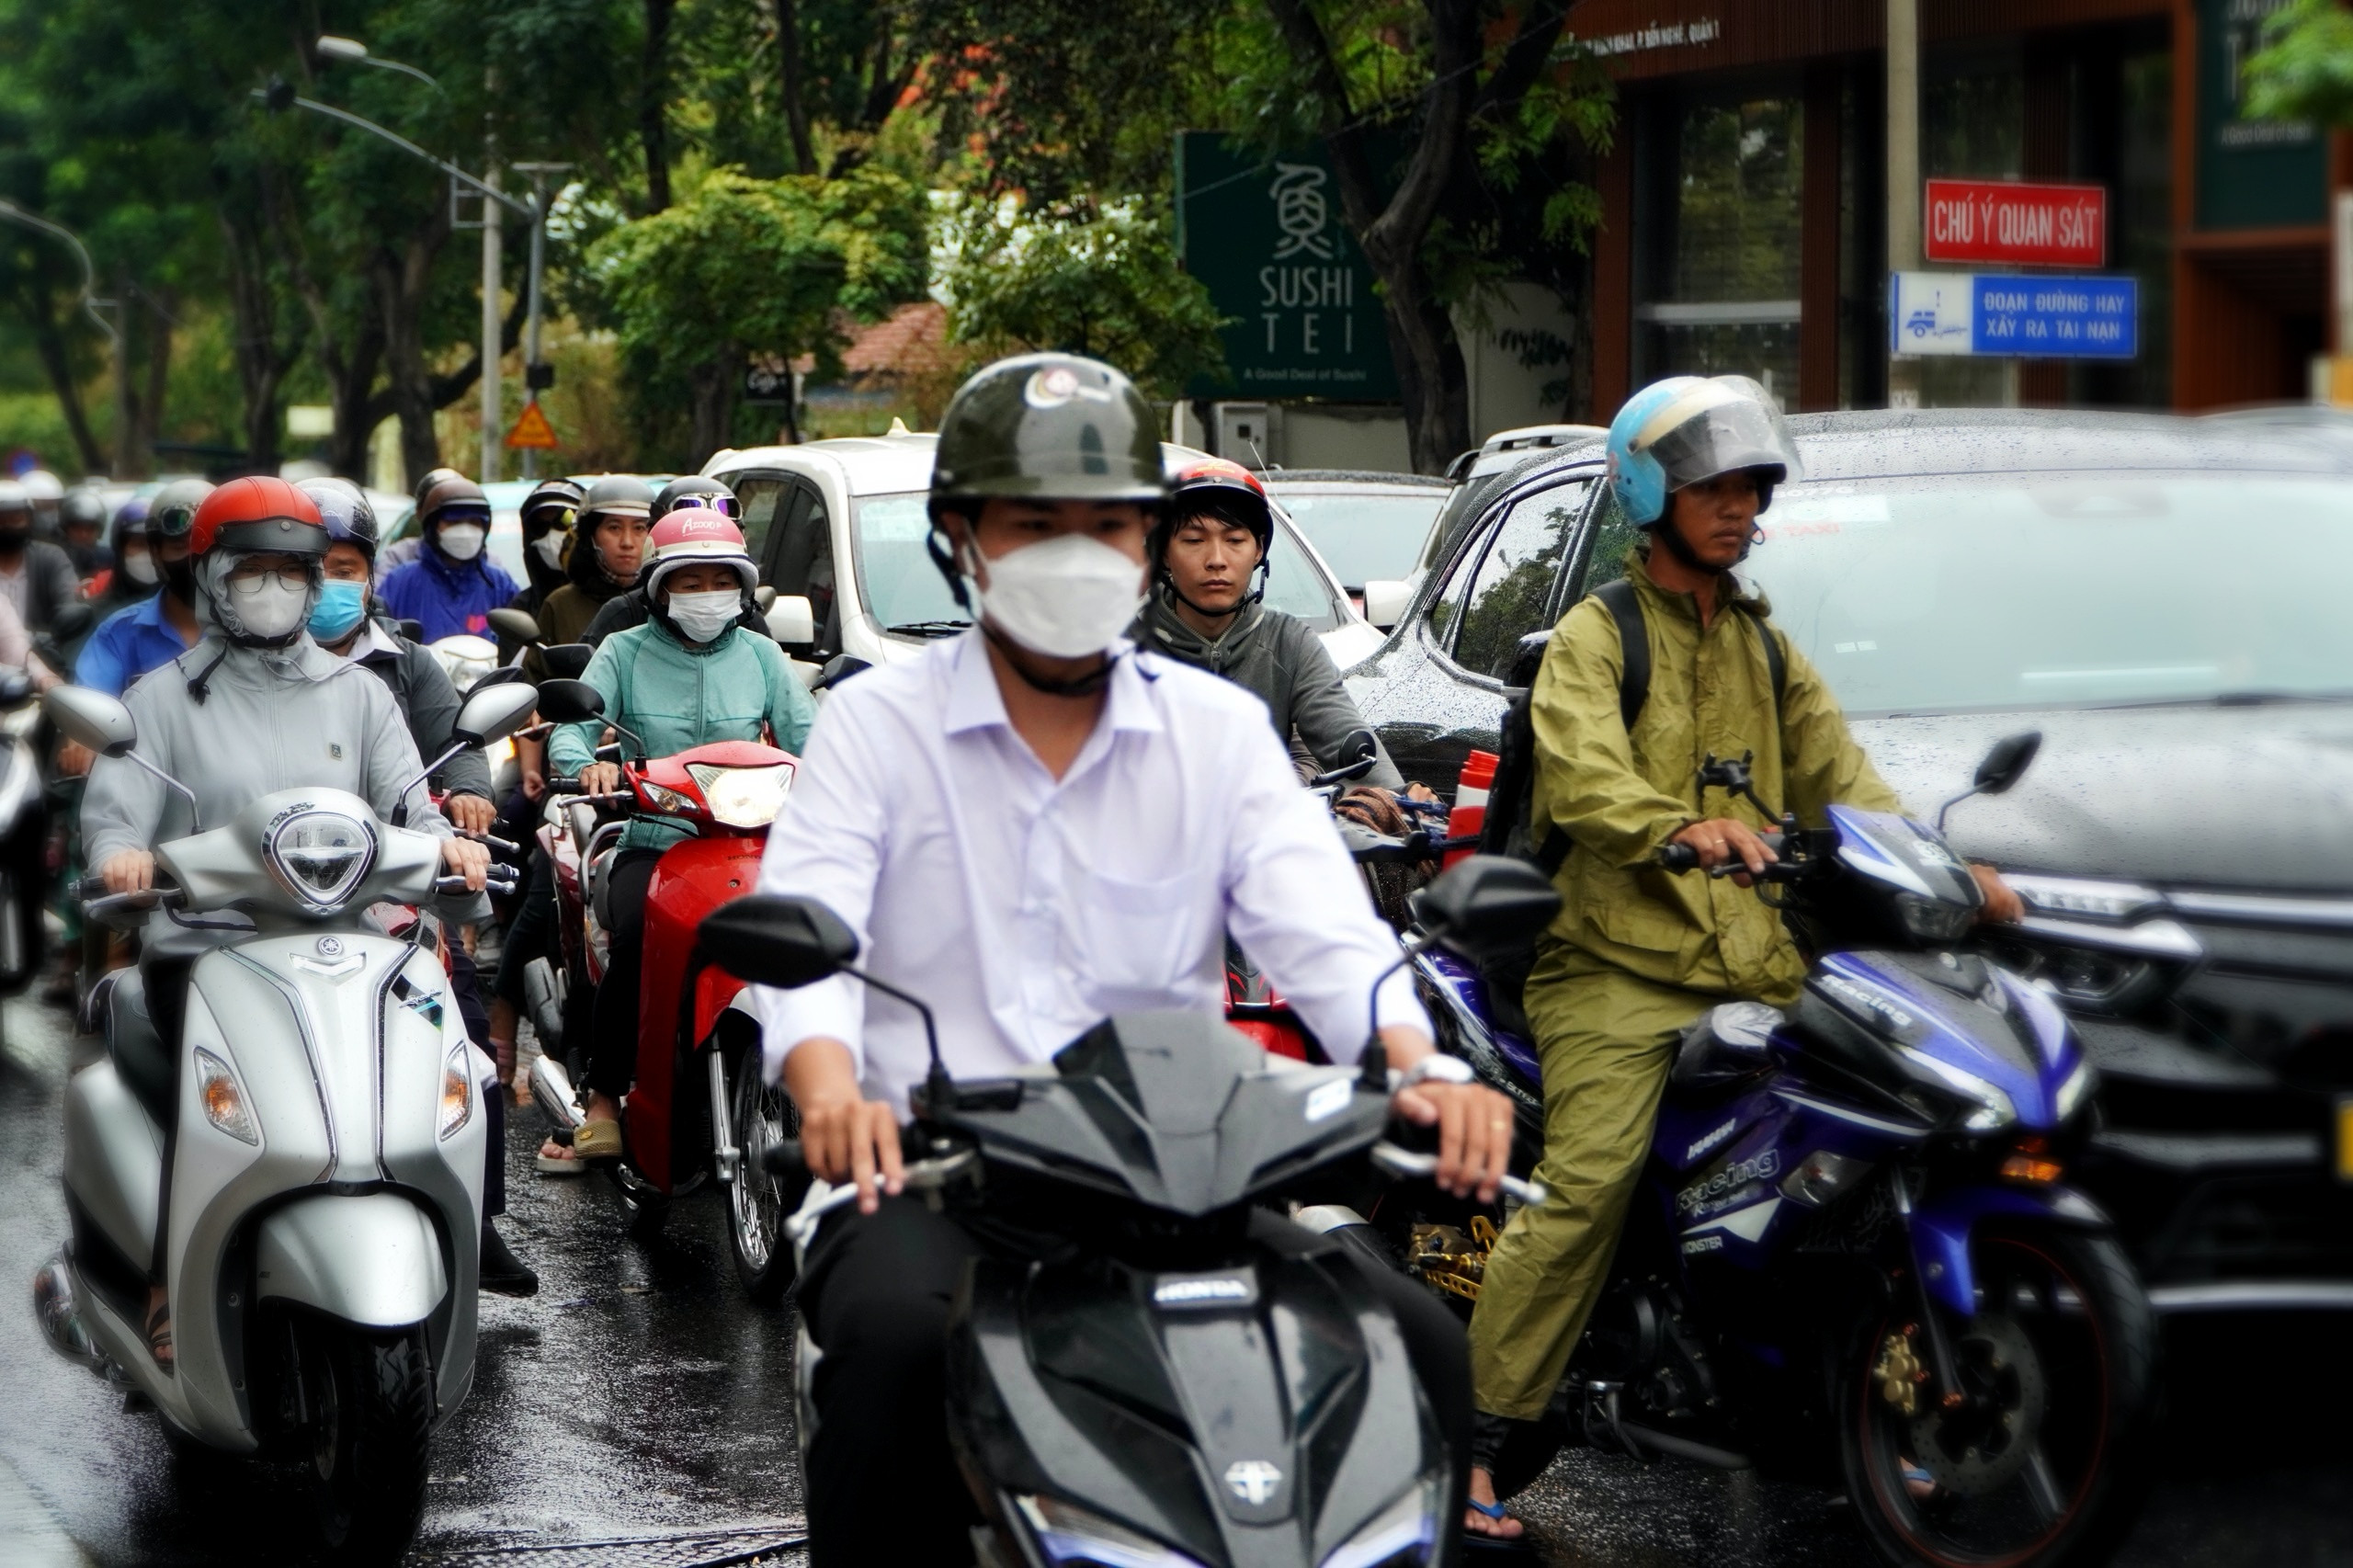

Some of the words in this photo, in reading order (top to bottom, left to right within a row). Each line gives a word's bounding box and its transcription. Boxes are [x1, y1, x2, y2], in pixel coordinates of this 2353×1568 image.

[1934, 191, 1974, 244] CHÚ
[1981, 192, 1995, 245] Ý
[1998, 203, 2053, 247] QUAN
[2058, 197, 2098, 248] SÁT
[1259, 266, 1353, 307] SUSHI
[1984, 291, 2029, 315] ĐOẠN
[2096, 294, 2126, 314] HAY
[2026, 318, 2048, 338] RA
[2056, 319, 2079, 339] TAI
[2086, 320, 2120, 344] NẠN
[1822, 974, 1912, 1027] Racing
[1676, 1149, 1781, 1217] Racing
